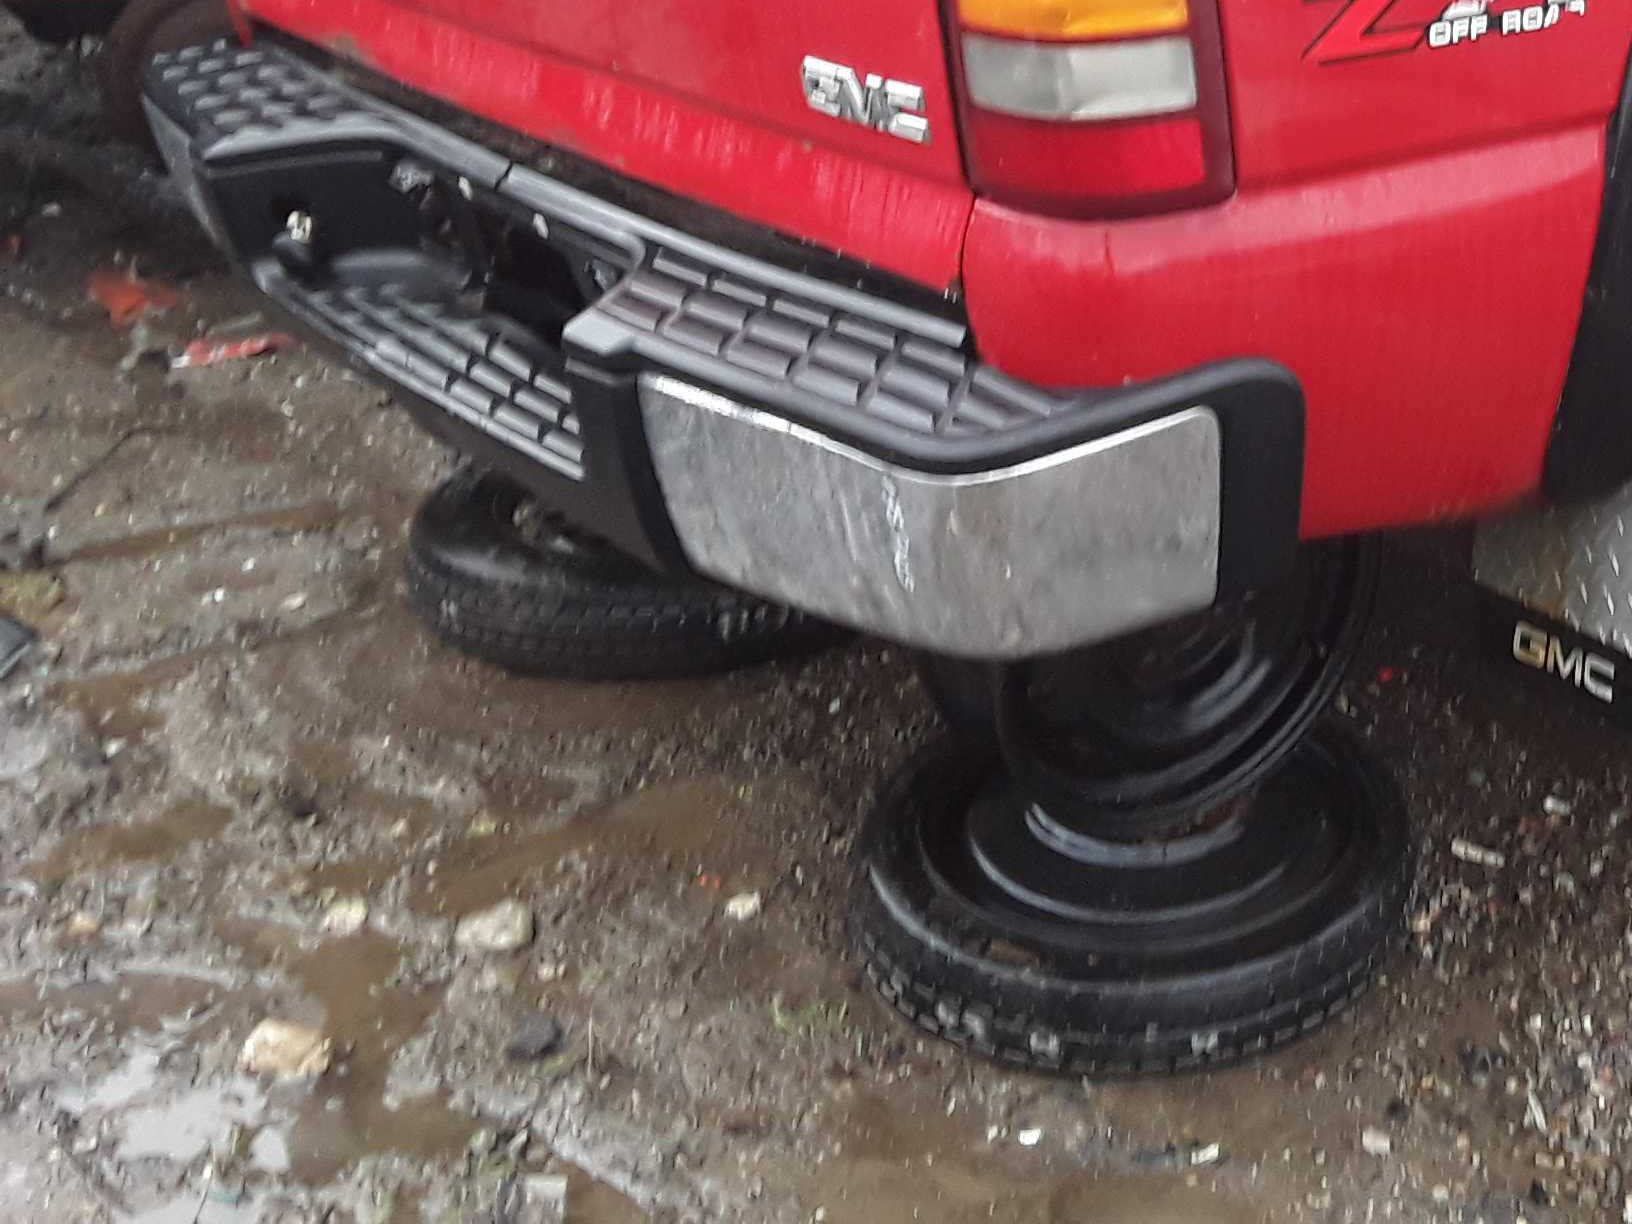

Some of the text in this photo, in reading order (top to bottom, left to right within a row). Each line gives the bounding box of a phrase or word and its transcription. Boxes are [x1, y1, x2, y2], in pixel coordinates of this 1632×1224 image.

[1427, 14, 1488, 49] OFF
[801, 54, 932, 145] GMC
[1512, 620, 1616, 704] GMC
